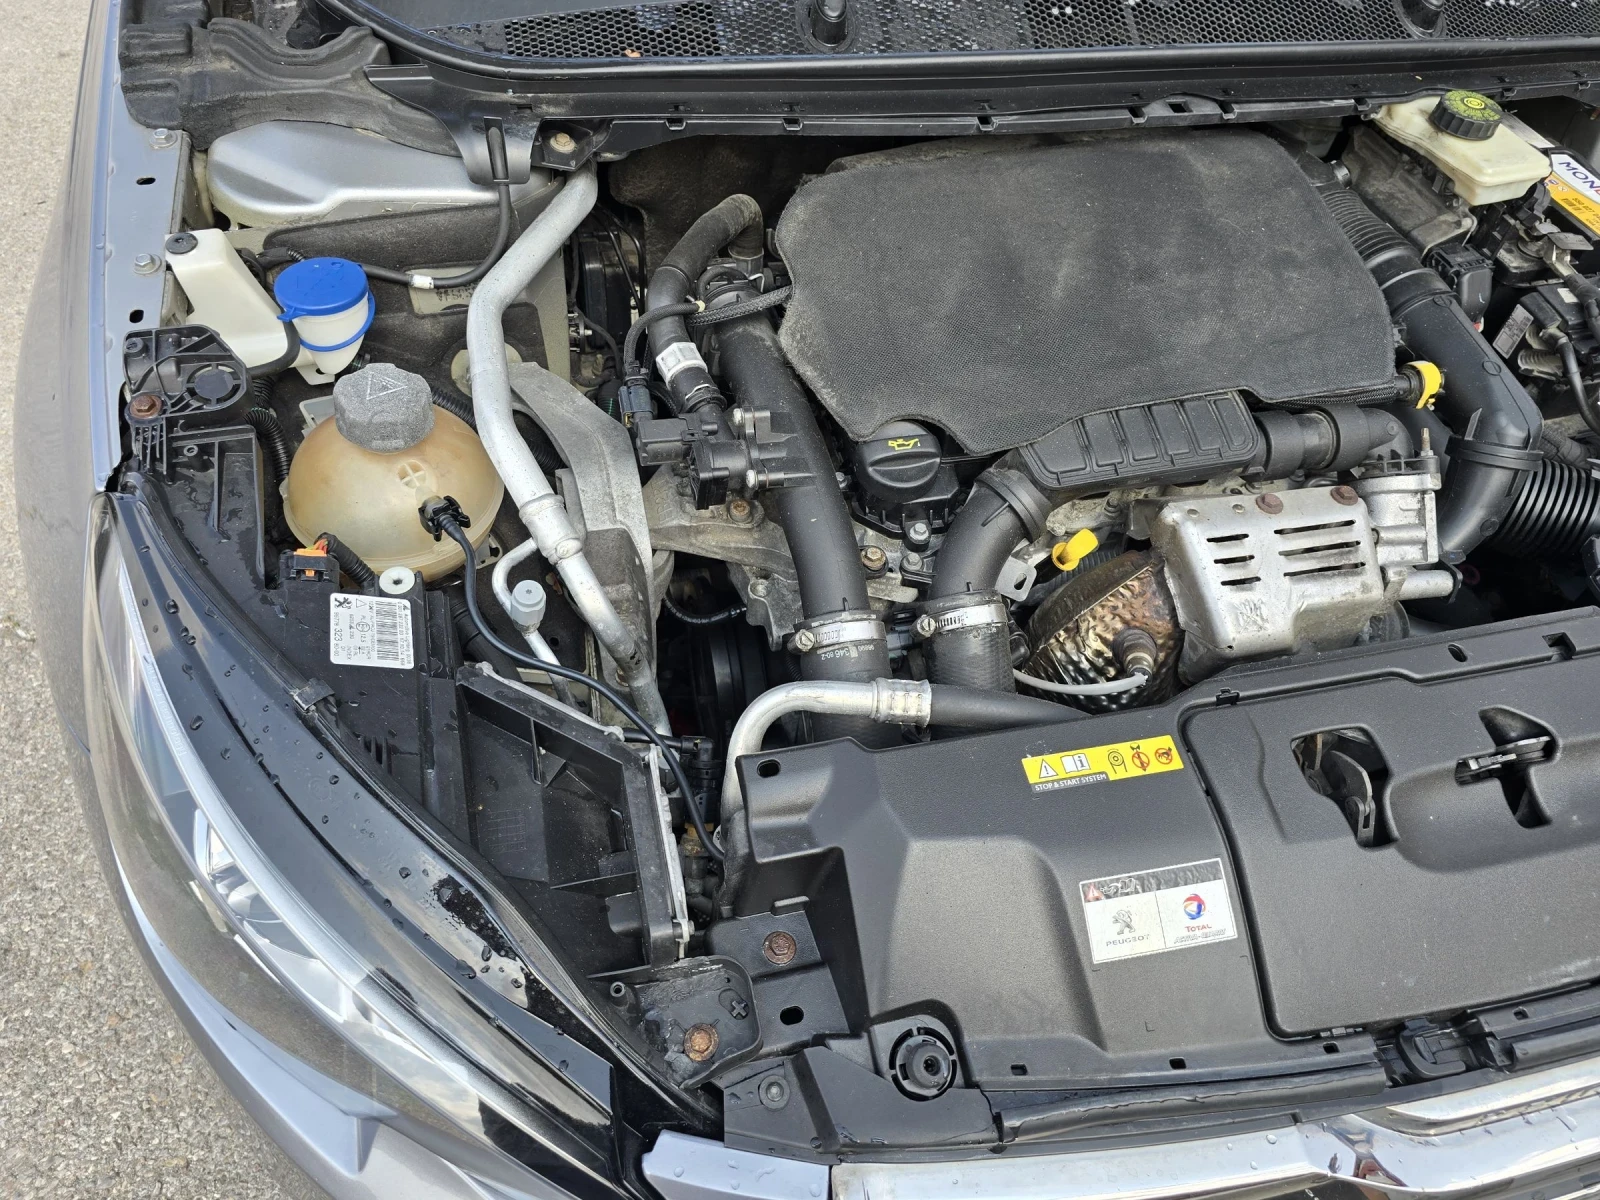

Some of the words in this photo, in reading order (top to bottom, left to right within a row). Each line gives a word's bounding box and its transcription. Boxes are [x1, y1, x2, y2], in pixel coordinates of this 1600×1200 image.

[334, 628, 343, 641] 323
[834, 648, 850, 658] 346
[1035, 783, 1053, 791] STOP
[1060, 777, 1080, 787] START
[1081, 773, 1107, 784] SYSTEM
[1105, 934, 1150, 947] PEUGEOT
